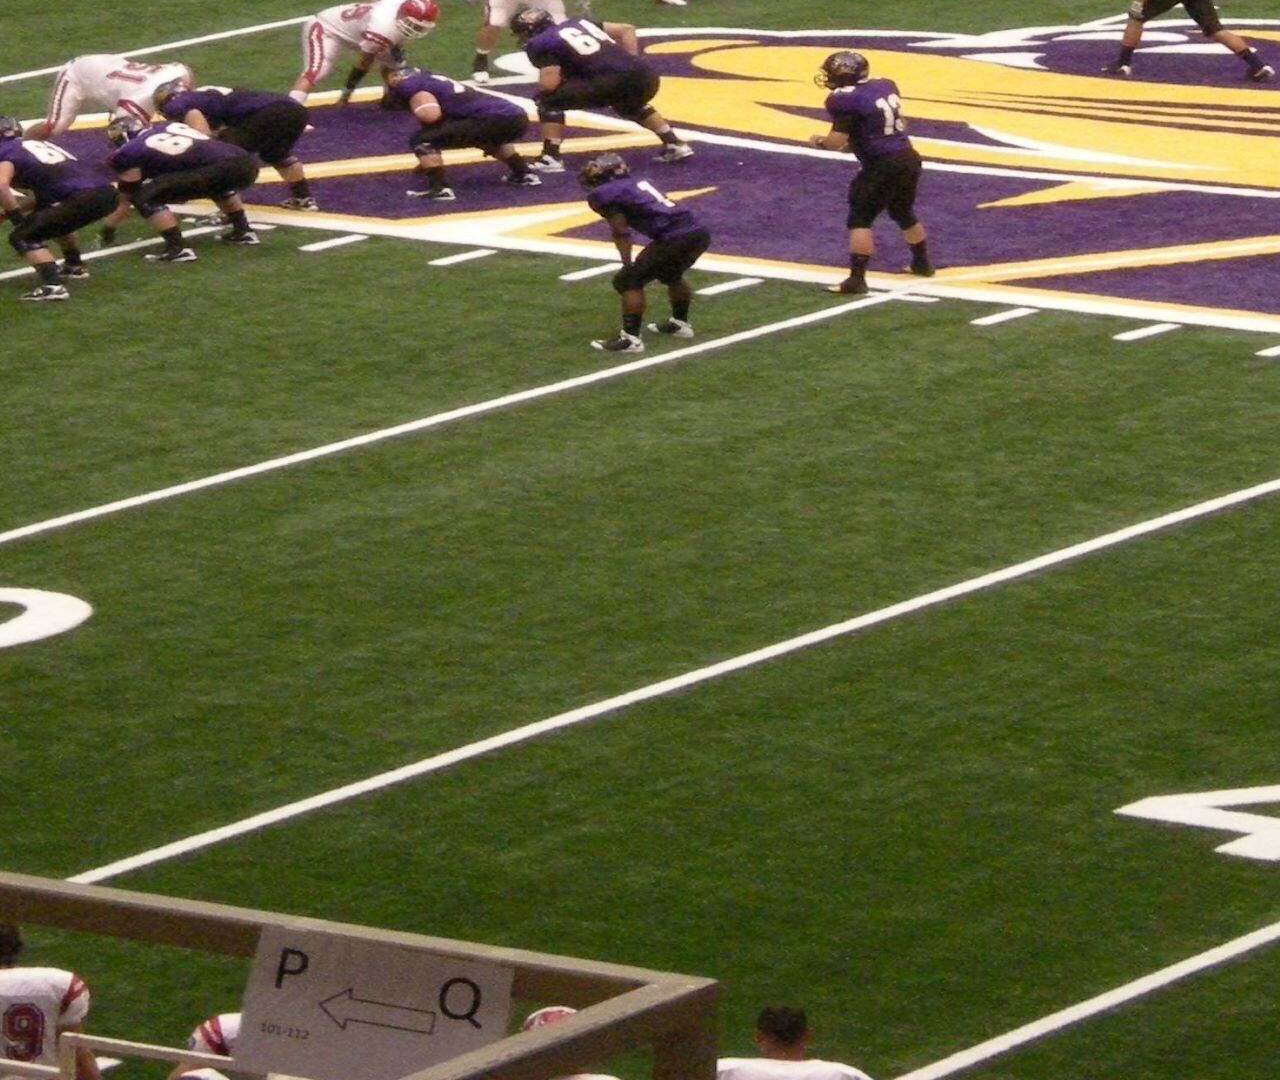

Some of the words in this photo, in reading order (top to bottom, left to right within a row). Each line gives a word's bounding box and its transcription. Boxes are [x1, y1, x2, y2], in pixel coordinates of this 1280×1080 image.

[637, 180, 676, 208] 1
[275, 948, 309, 990] P
[439, 977, 483, 1029] Q
[260, 1022, 310, 1040] 101-112
